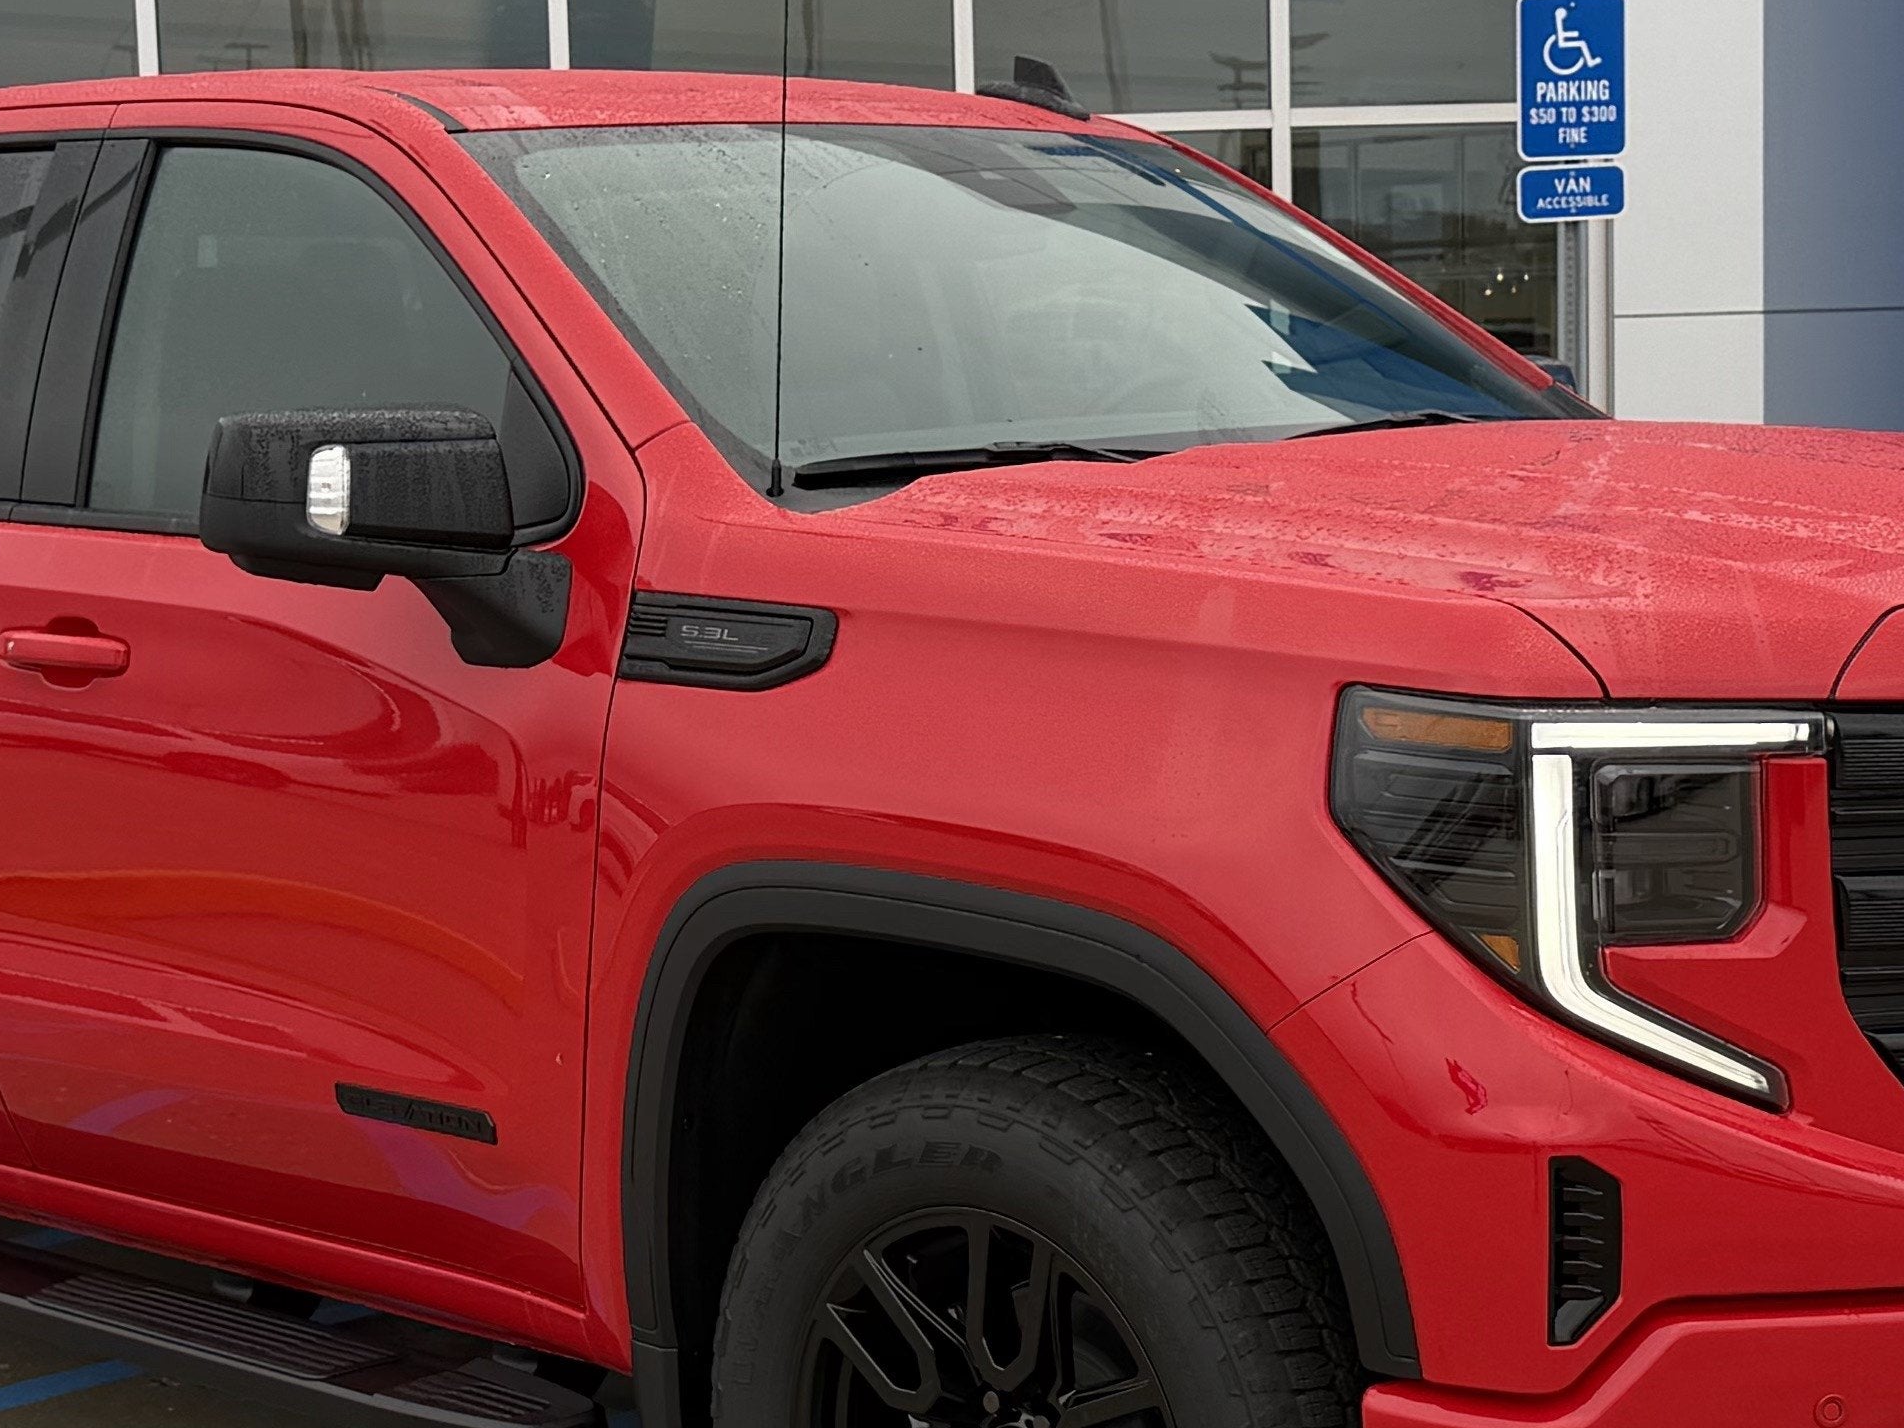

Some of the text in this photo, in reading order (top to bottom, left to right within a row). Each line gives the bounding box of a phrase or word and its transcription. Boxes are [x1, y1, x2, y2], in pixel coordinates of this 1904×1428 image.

[1536, 79, 1610, 103] PARKING
[1529, 105, 1617, 125] $50 TO $300
[1558, 126, 1588, 143] FINE
[1554, 176, 1591, 194] VAN
[1536, 194, 1610, 210] ACCESSIBLE
[680, 625, 739, 641] 5.3L
